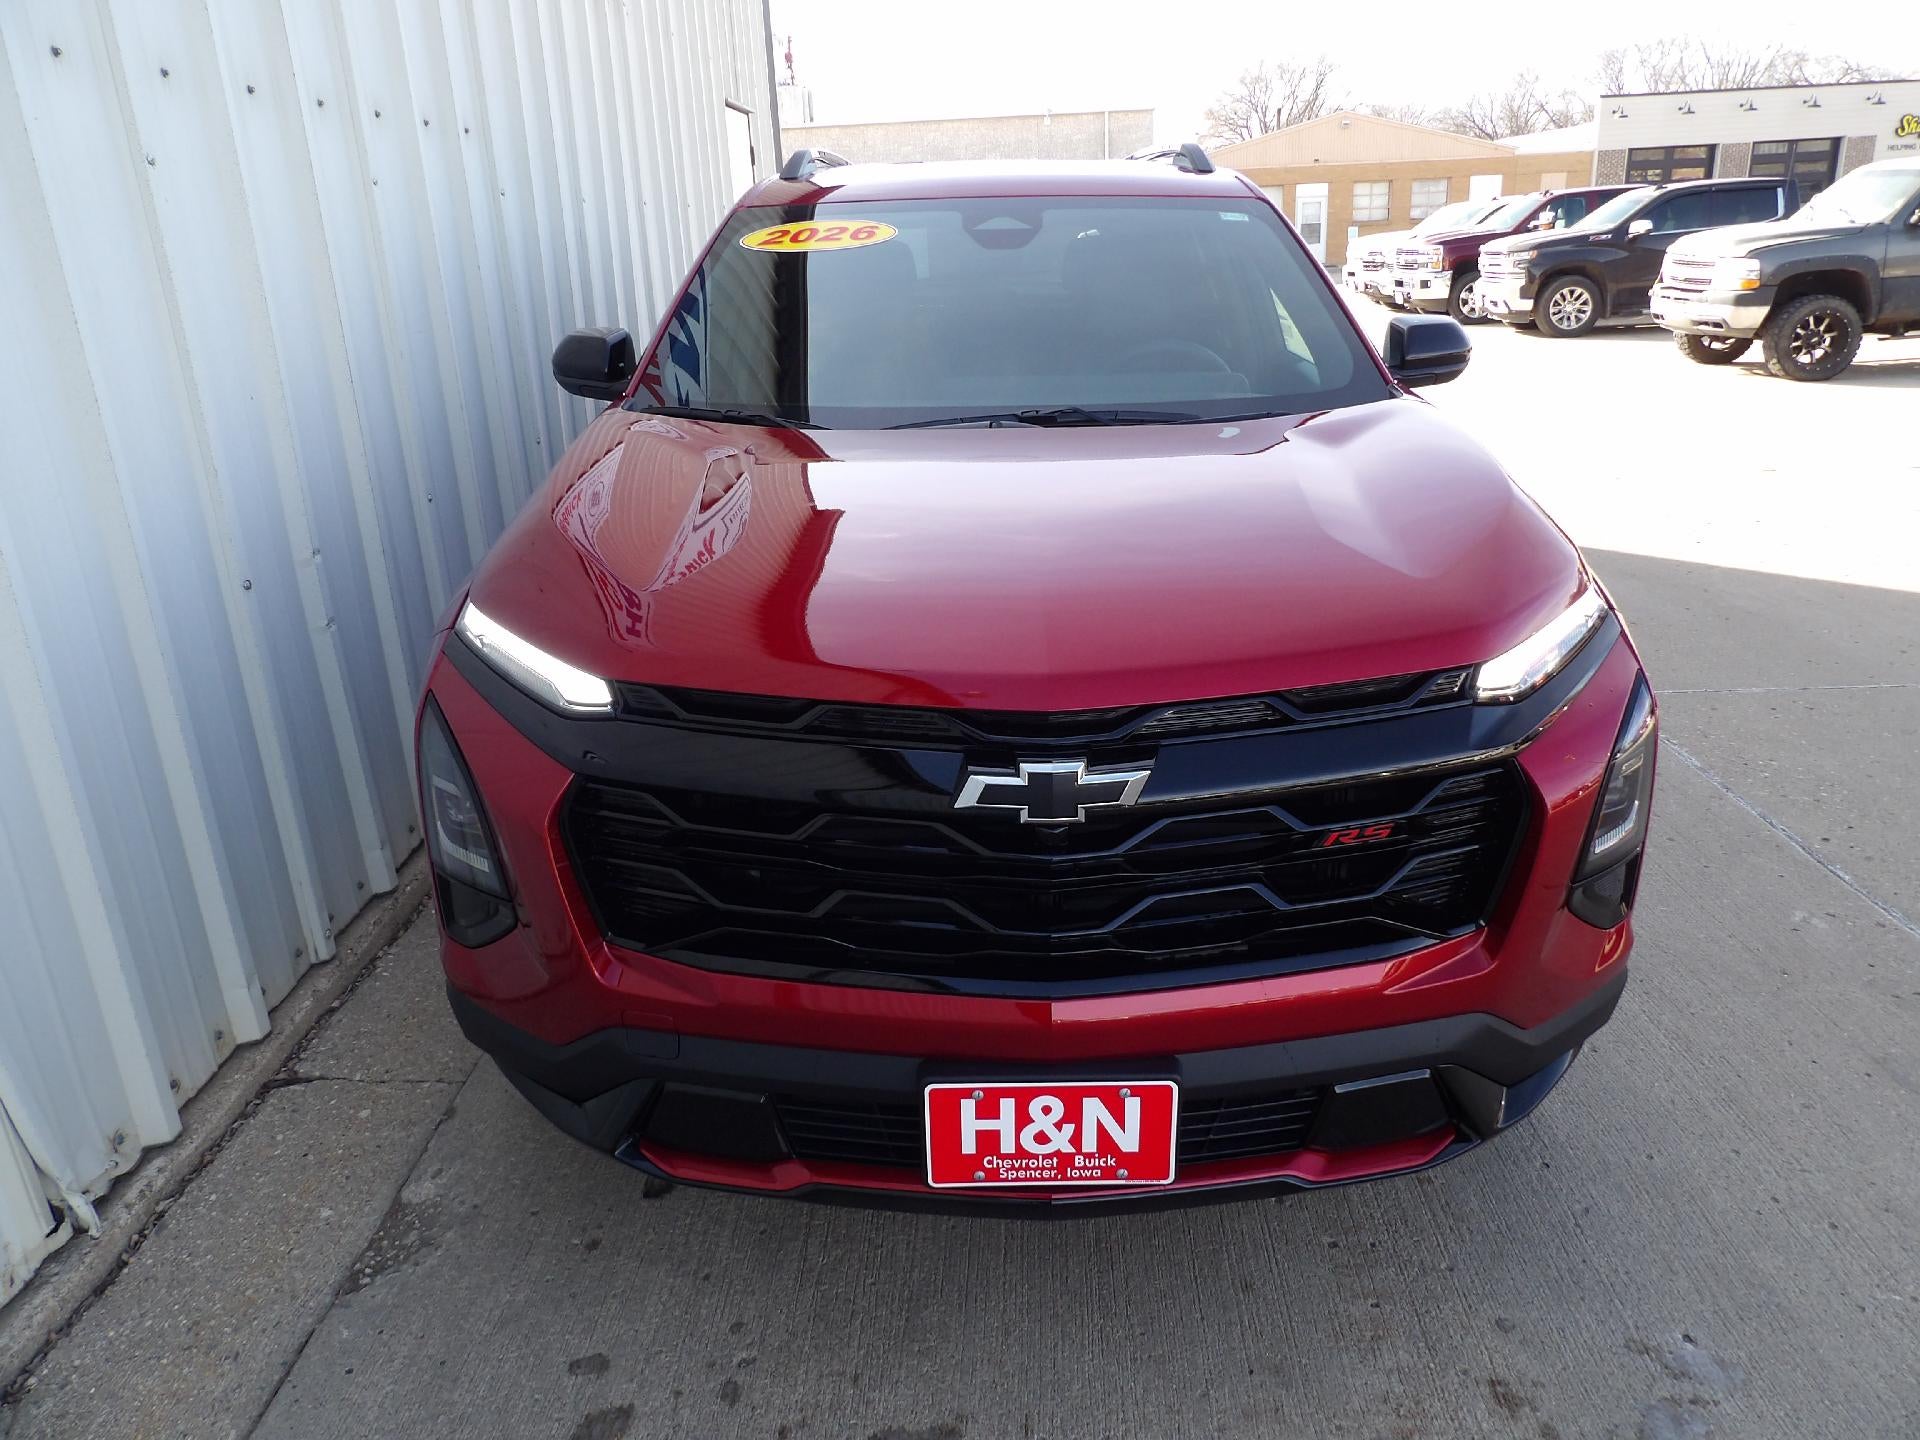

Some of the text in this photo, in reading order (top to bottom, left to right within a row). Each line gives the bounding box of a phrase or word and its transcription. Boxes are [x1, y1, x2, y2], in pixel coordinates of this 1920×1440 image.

[755, 225, 881, 246] 2026
[1322, 822, 1396, 848] RS
[960, 1094, 1141, 1155] H&N
[983, 1154, 1116, 1169] Chevrolet Buick
[999, 1167, 1101, 1180] Spencer, Iowa
